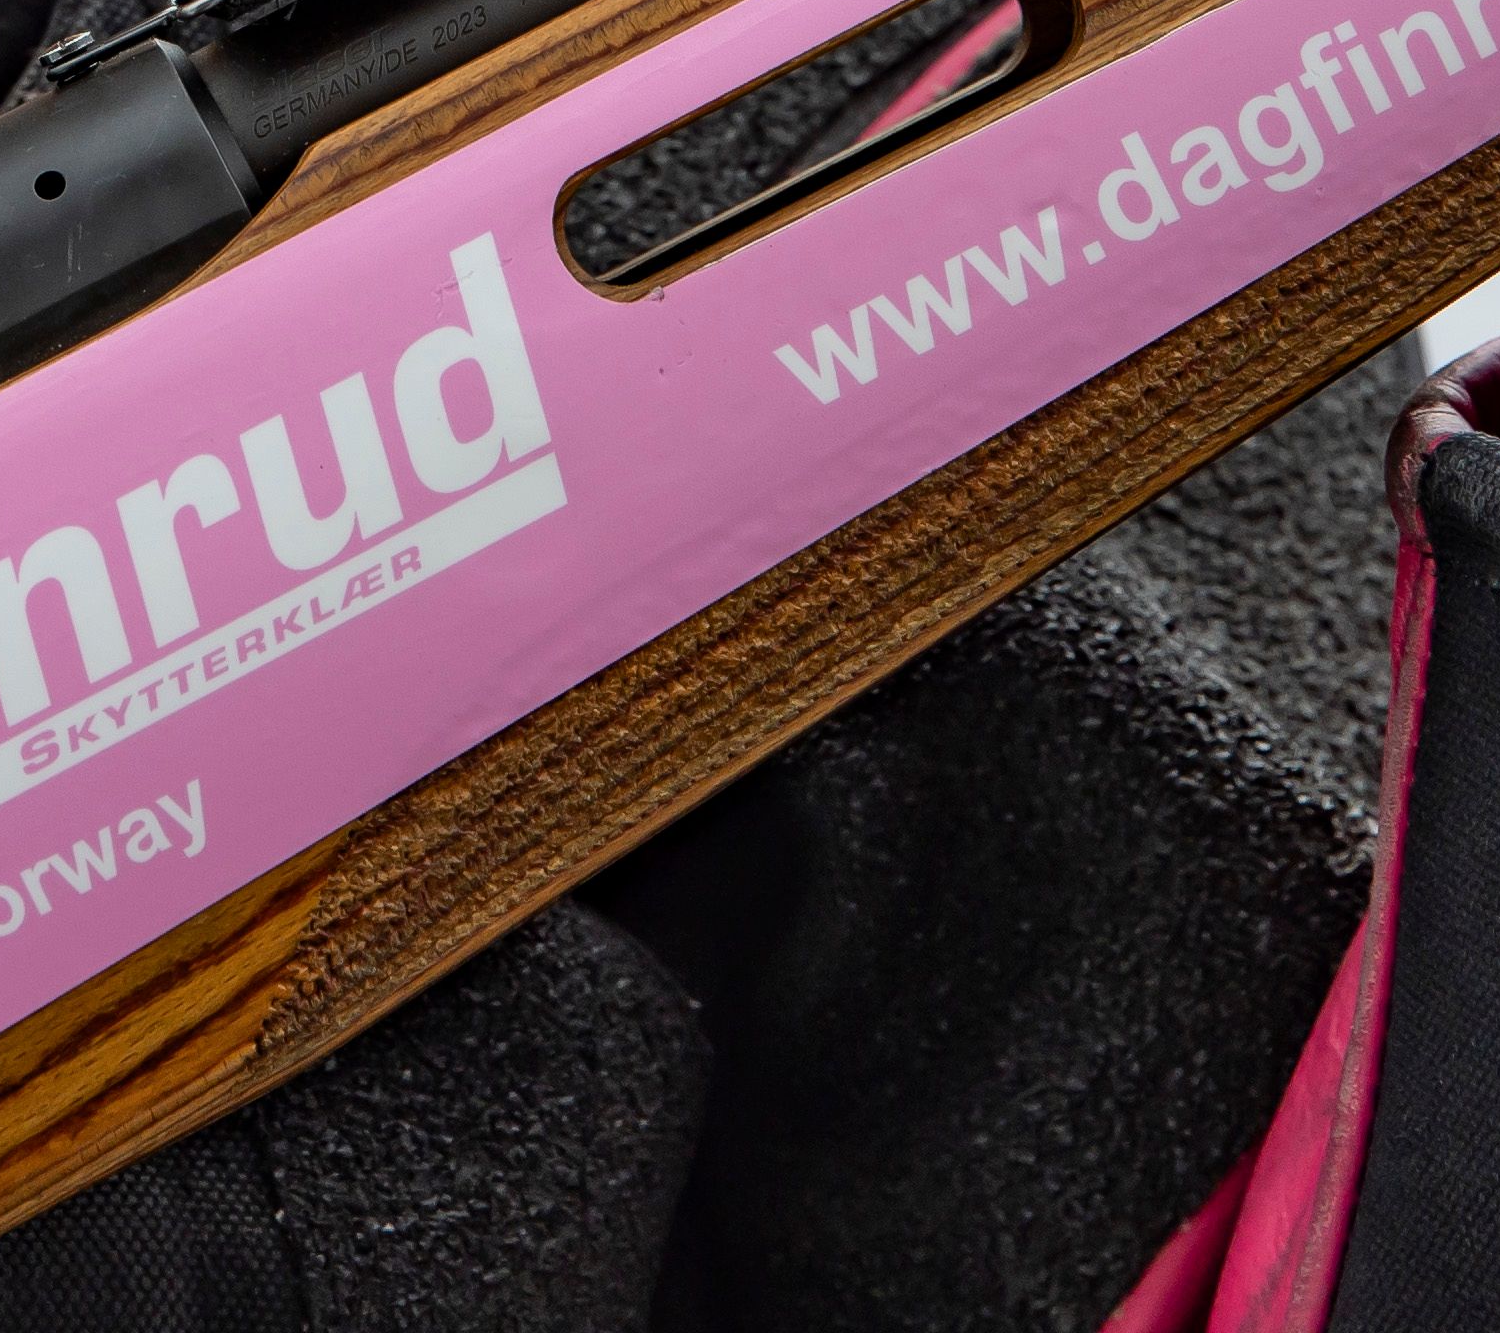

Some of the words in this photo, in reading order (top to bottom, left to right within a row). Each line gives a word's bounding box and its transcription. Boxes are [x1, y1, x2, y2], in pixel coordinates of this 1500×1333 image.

[254, 38, 418, 139] GERMANY/DE
[432, 4, 487, 51] 2023
[20, 545, 422, 775] SKYTTERKLÆR
